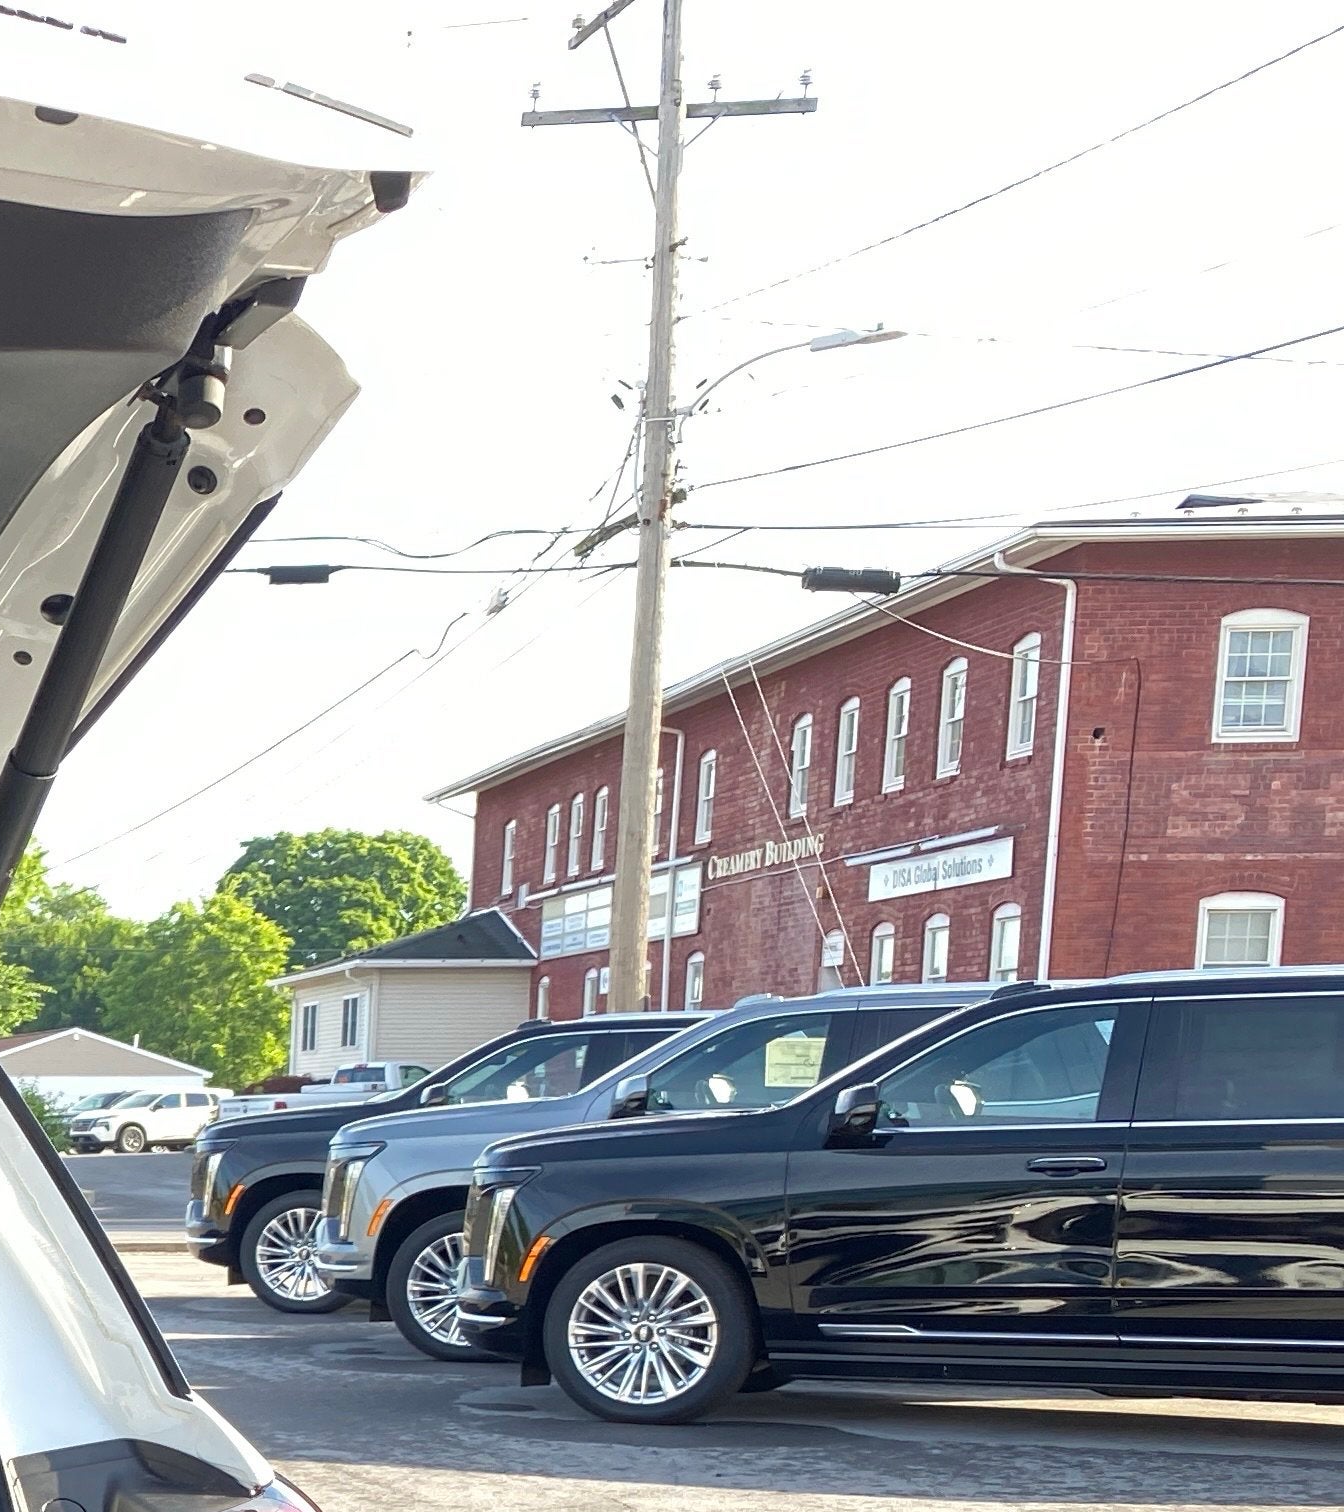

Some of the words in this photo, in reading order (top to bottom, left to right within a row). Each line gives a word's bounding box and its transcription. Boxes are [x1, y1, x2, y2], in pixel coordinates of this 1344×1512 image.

[765, 833, 825, 867] BUILDING
[892, 866, 912, 889] DISA
[914, 860, 941, 884] Global
[942, 856, 983, 880] Solutions
